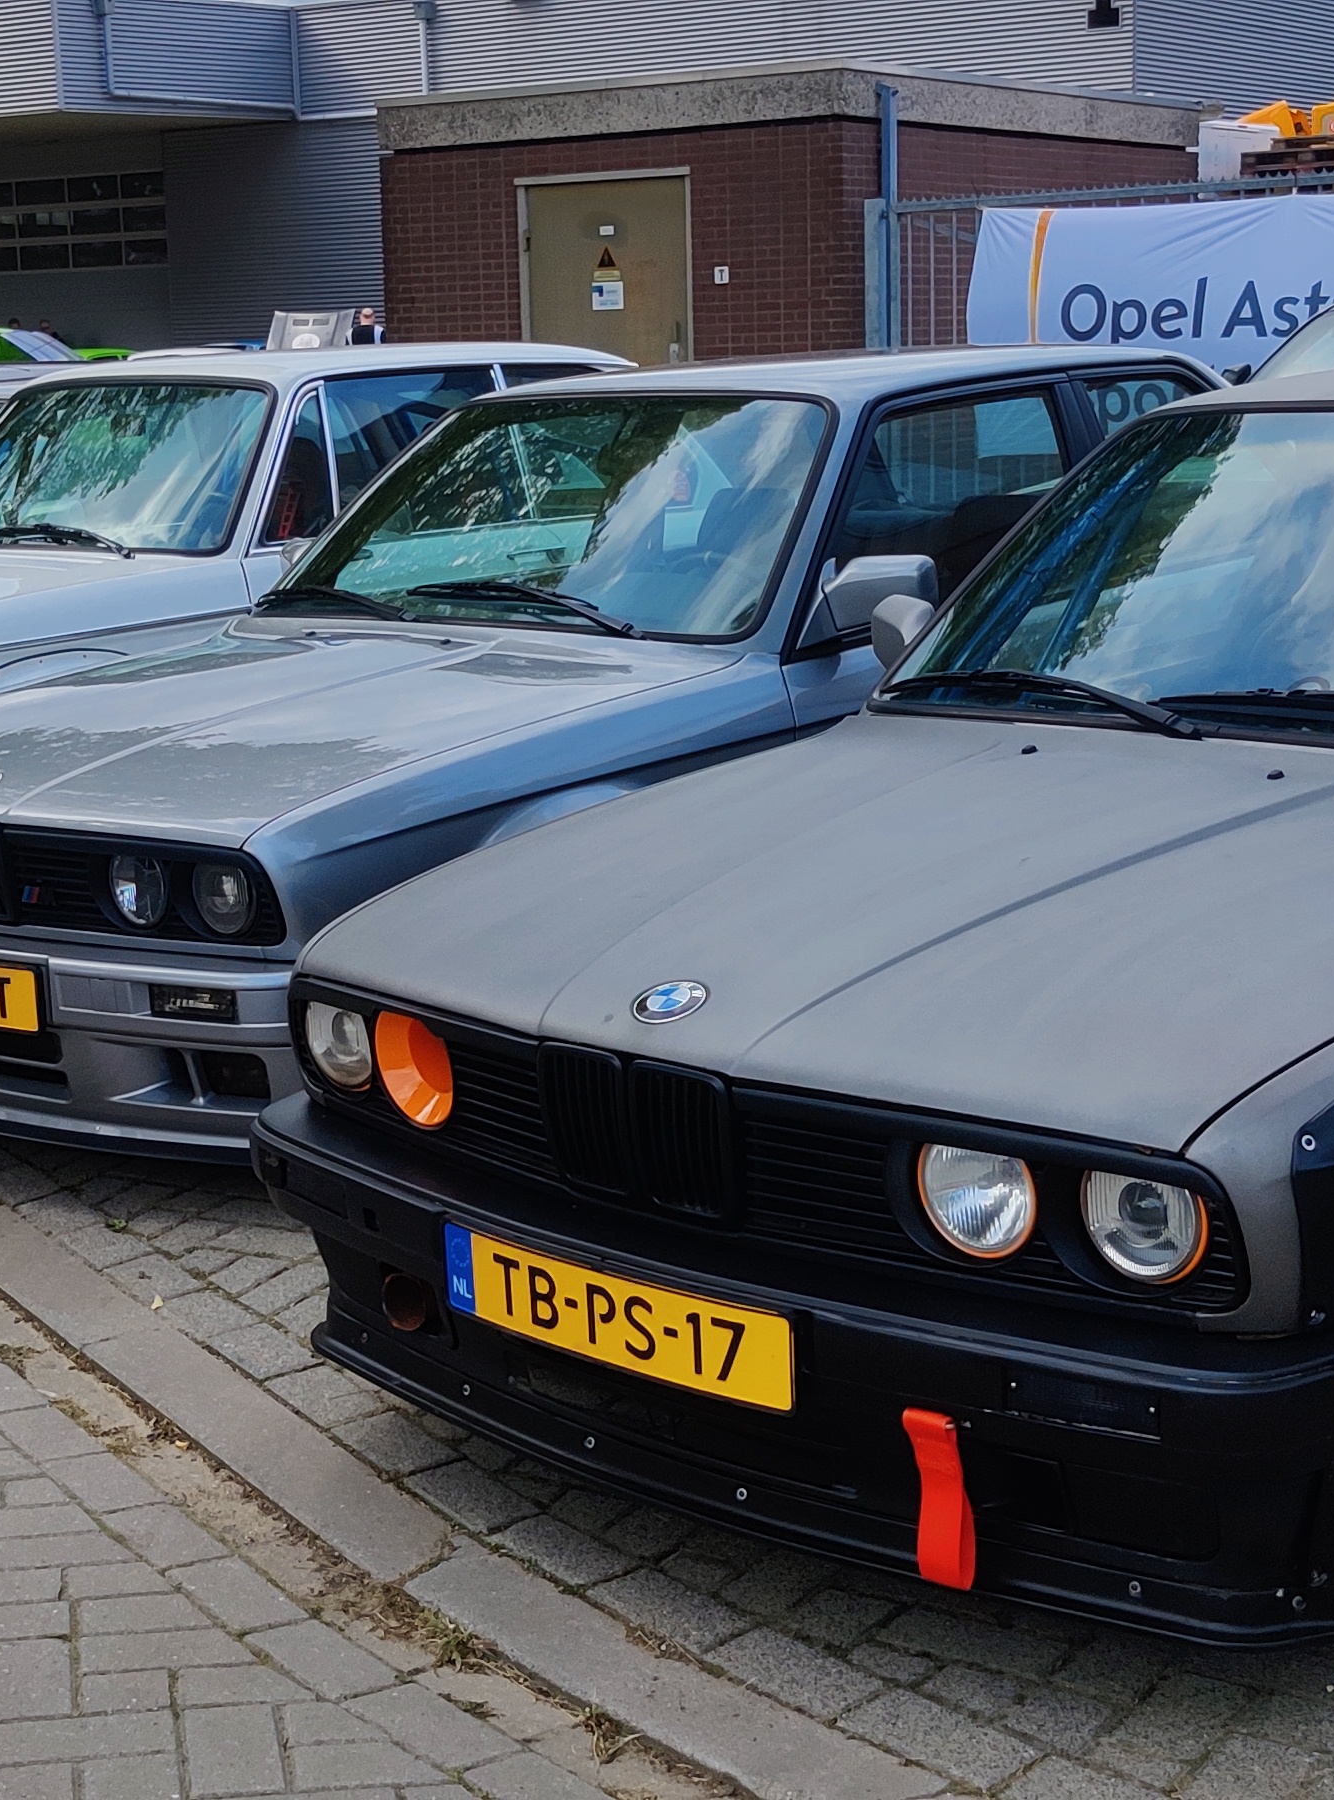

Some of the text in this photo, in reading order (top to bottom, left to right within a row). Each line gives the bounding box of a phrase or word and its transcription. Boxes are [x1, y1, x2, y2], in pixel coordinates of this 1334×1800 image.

[718, 268, 724, 282] T
[1060, 275, 1209, 345] Opel
[452, 1275, 473, 1299] NL
[492, 1252, 746, 1382] TB-PS-17
